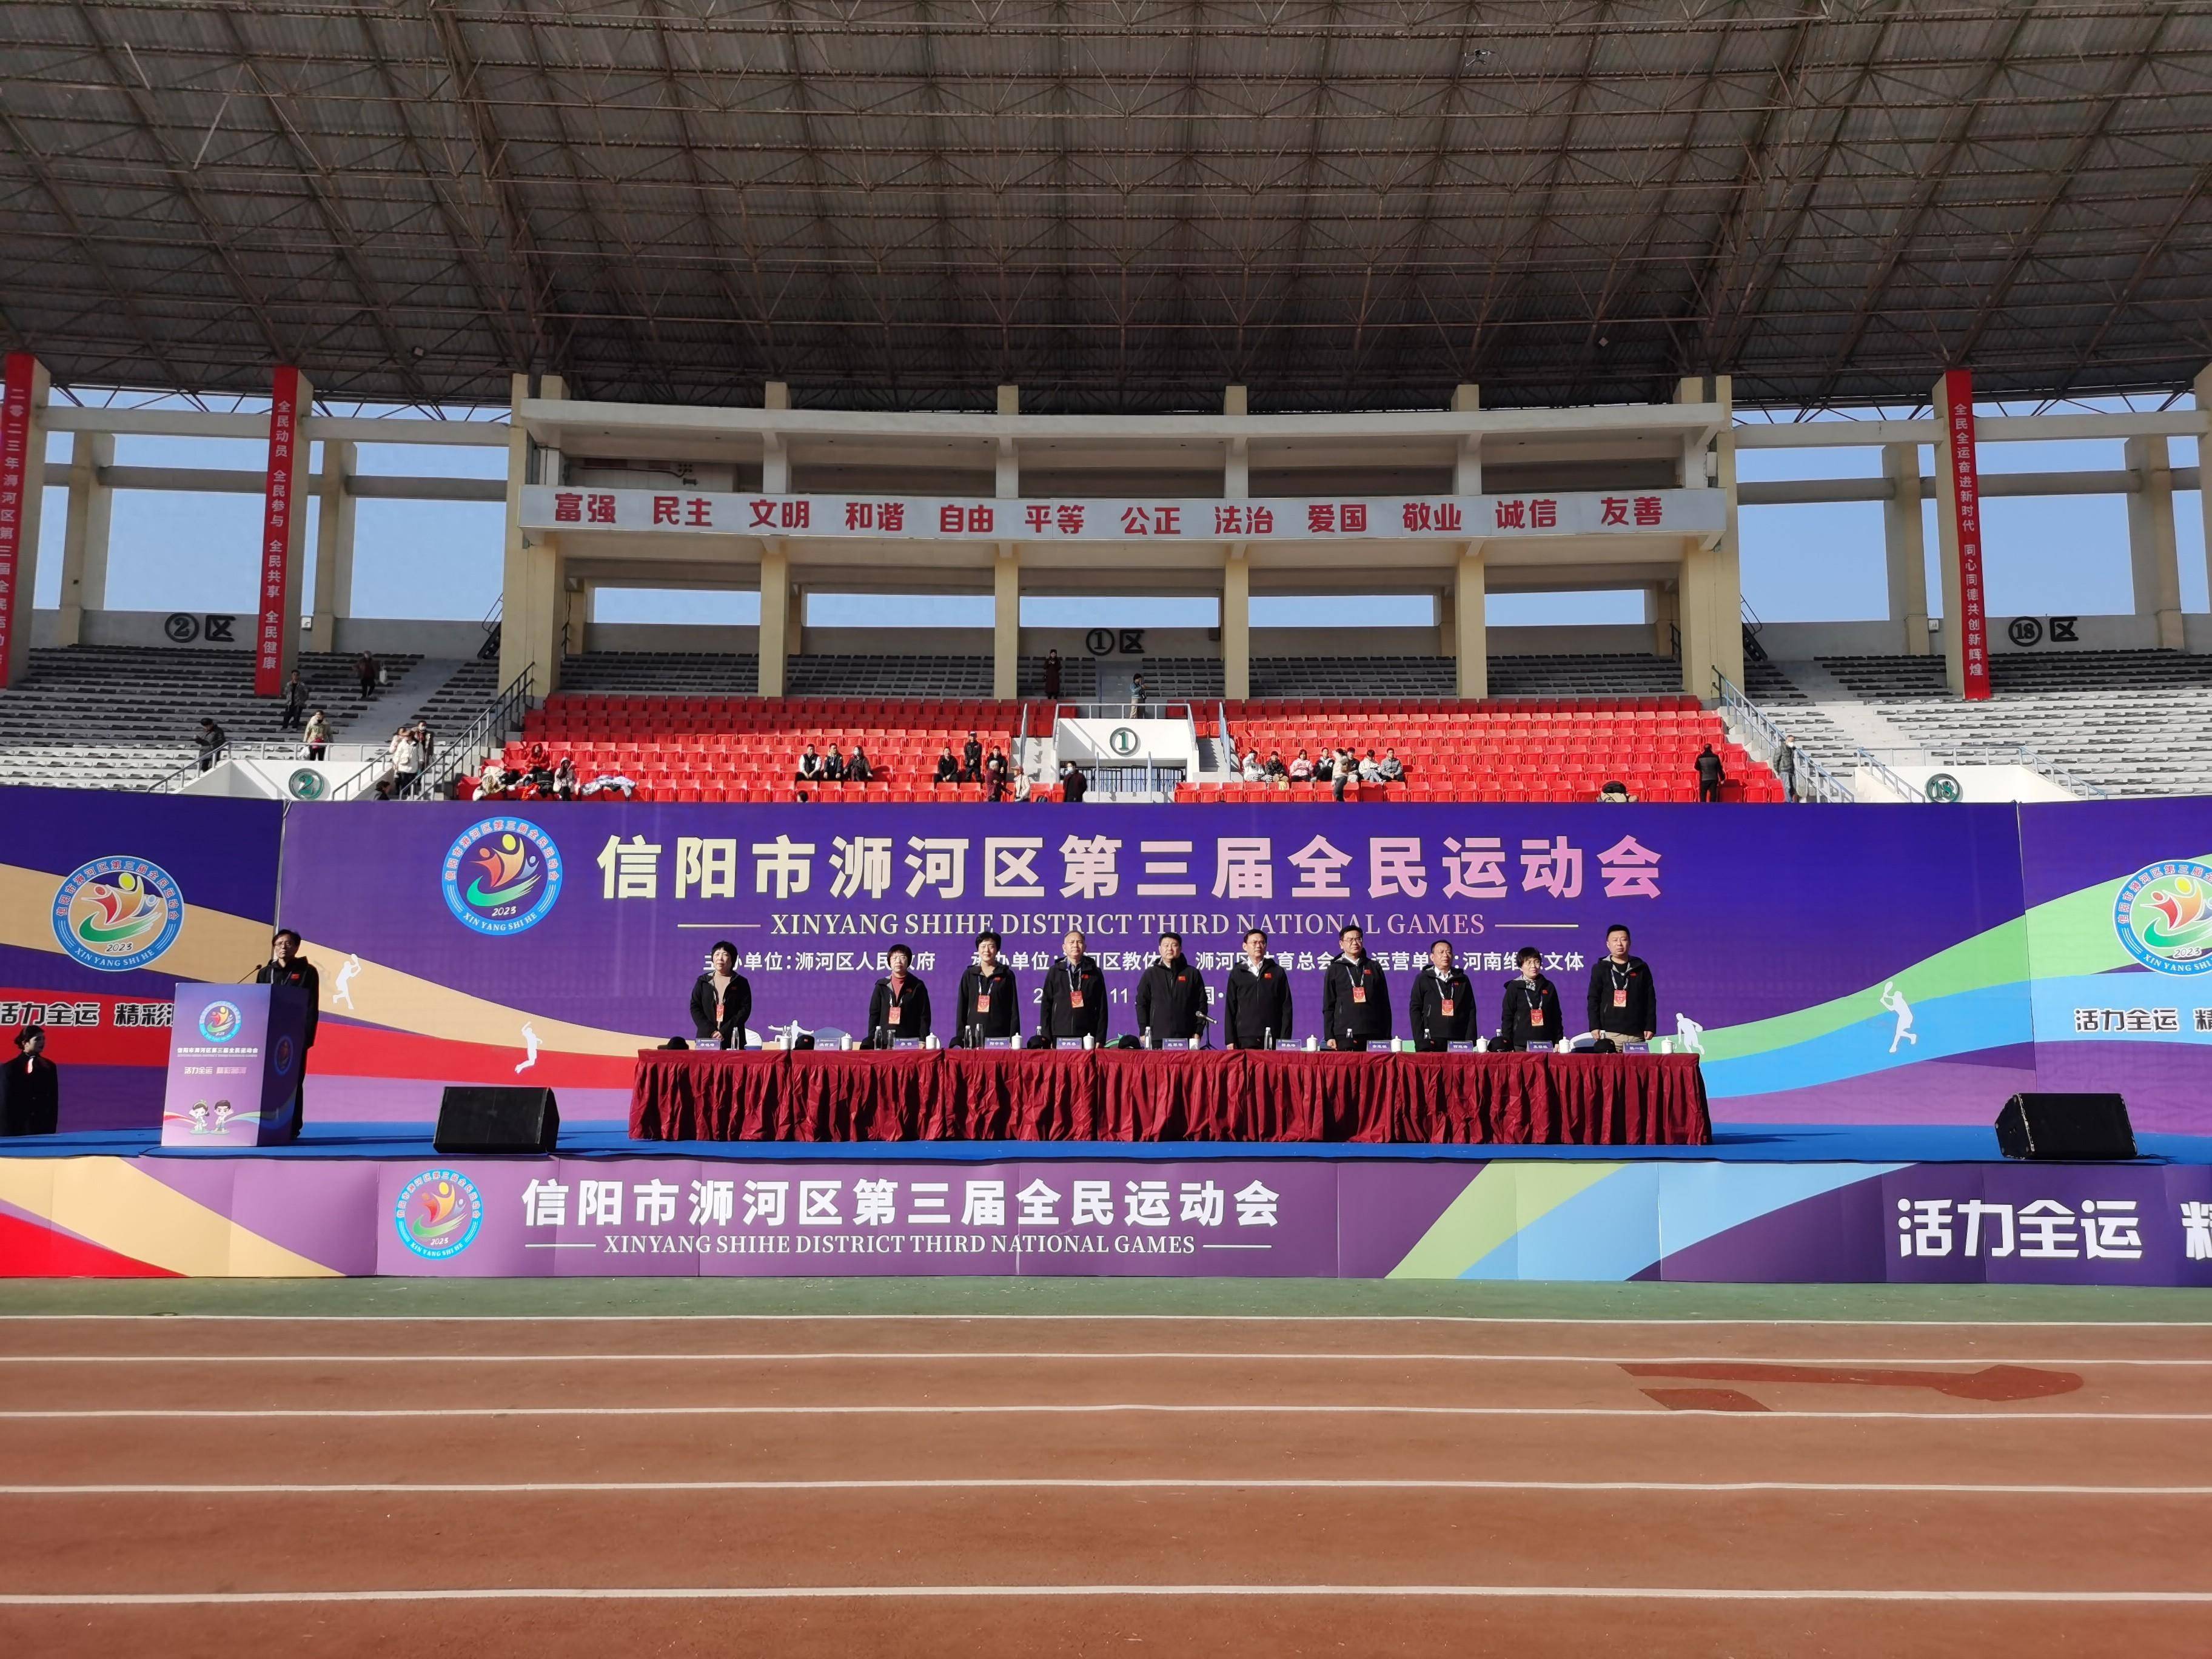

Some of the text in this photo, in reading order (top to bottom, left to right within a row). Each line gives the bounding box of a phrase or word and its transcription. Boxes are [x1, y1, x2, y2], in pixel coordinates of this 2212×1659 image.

[555, 494, 1663, 535] 富强 民主 文明 和谐 自由 平等 公正 法治 爱国 敬业 诚信 友善
[262, 401, 290, 669] 全民动员 全民参与 全民共享 全民健康
[1954, 404, 1983, 677] 全民全运奋进新时代 同心同德共创新辉煌
[597, 834, 1662, 899] 信阳市浉河区第三届全民运动会
[463, 912, 538, 931] XIN YANG SHI HE
[492, 906, 517, 917] 2023
[770, 913, 1485, 934] XINYANG SHIHE DISTRICT THIRD NATIONAL GAMES
[75, 948, 155, 967] XIN YANG SHI HE
[106, 942, 133, 953] 2023
[2173, 947, 2202, 958] 2023
[2143, 953, 2162, 967] XIN
[2163, 962, 2192, 972] YANG
[2074, 1008, 2178, 1033] 活力全运
[521, 1178, 1280, 1227] 信阳市浉河区第三届全民运动会
[1897, 1198, 2142, 1259] 活力全运
[605, 1235, 1195, 1253] XINYANG SHIHE DISTRICT THIRD NATIONAL GAMES
